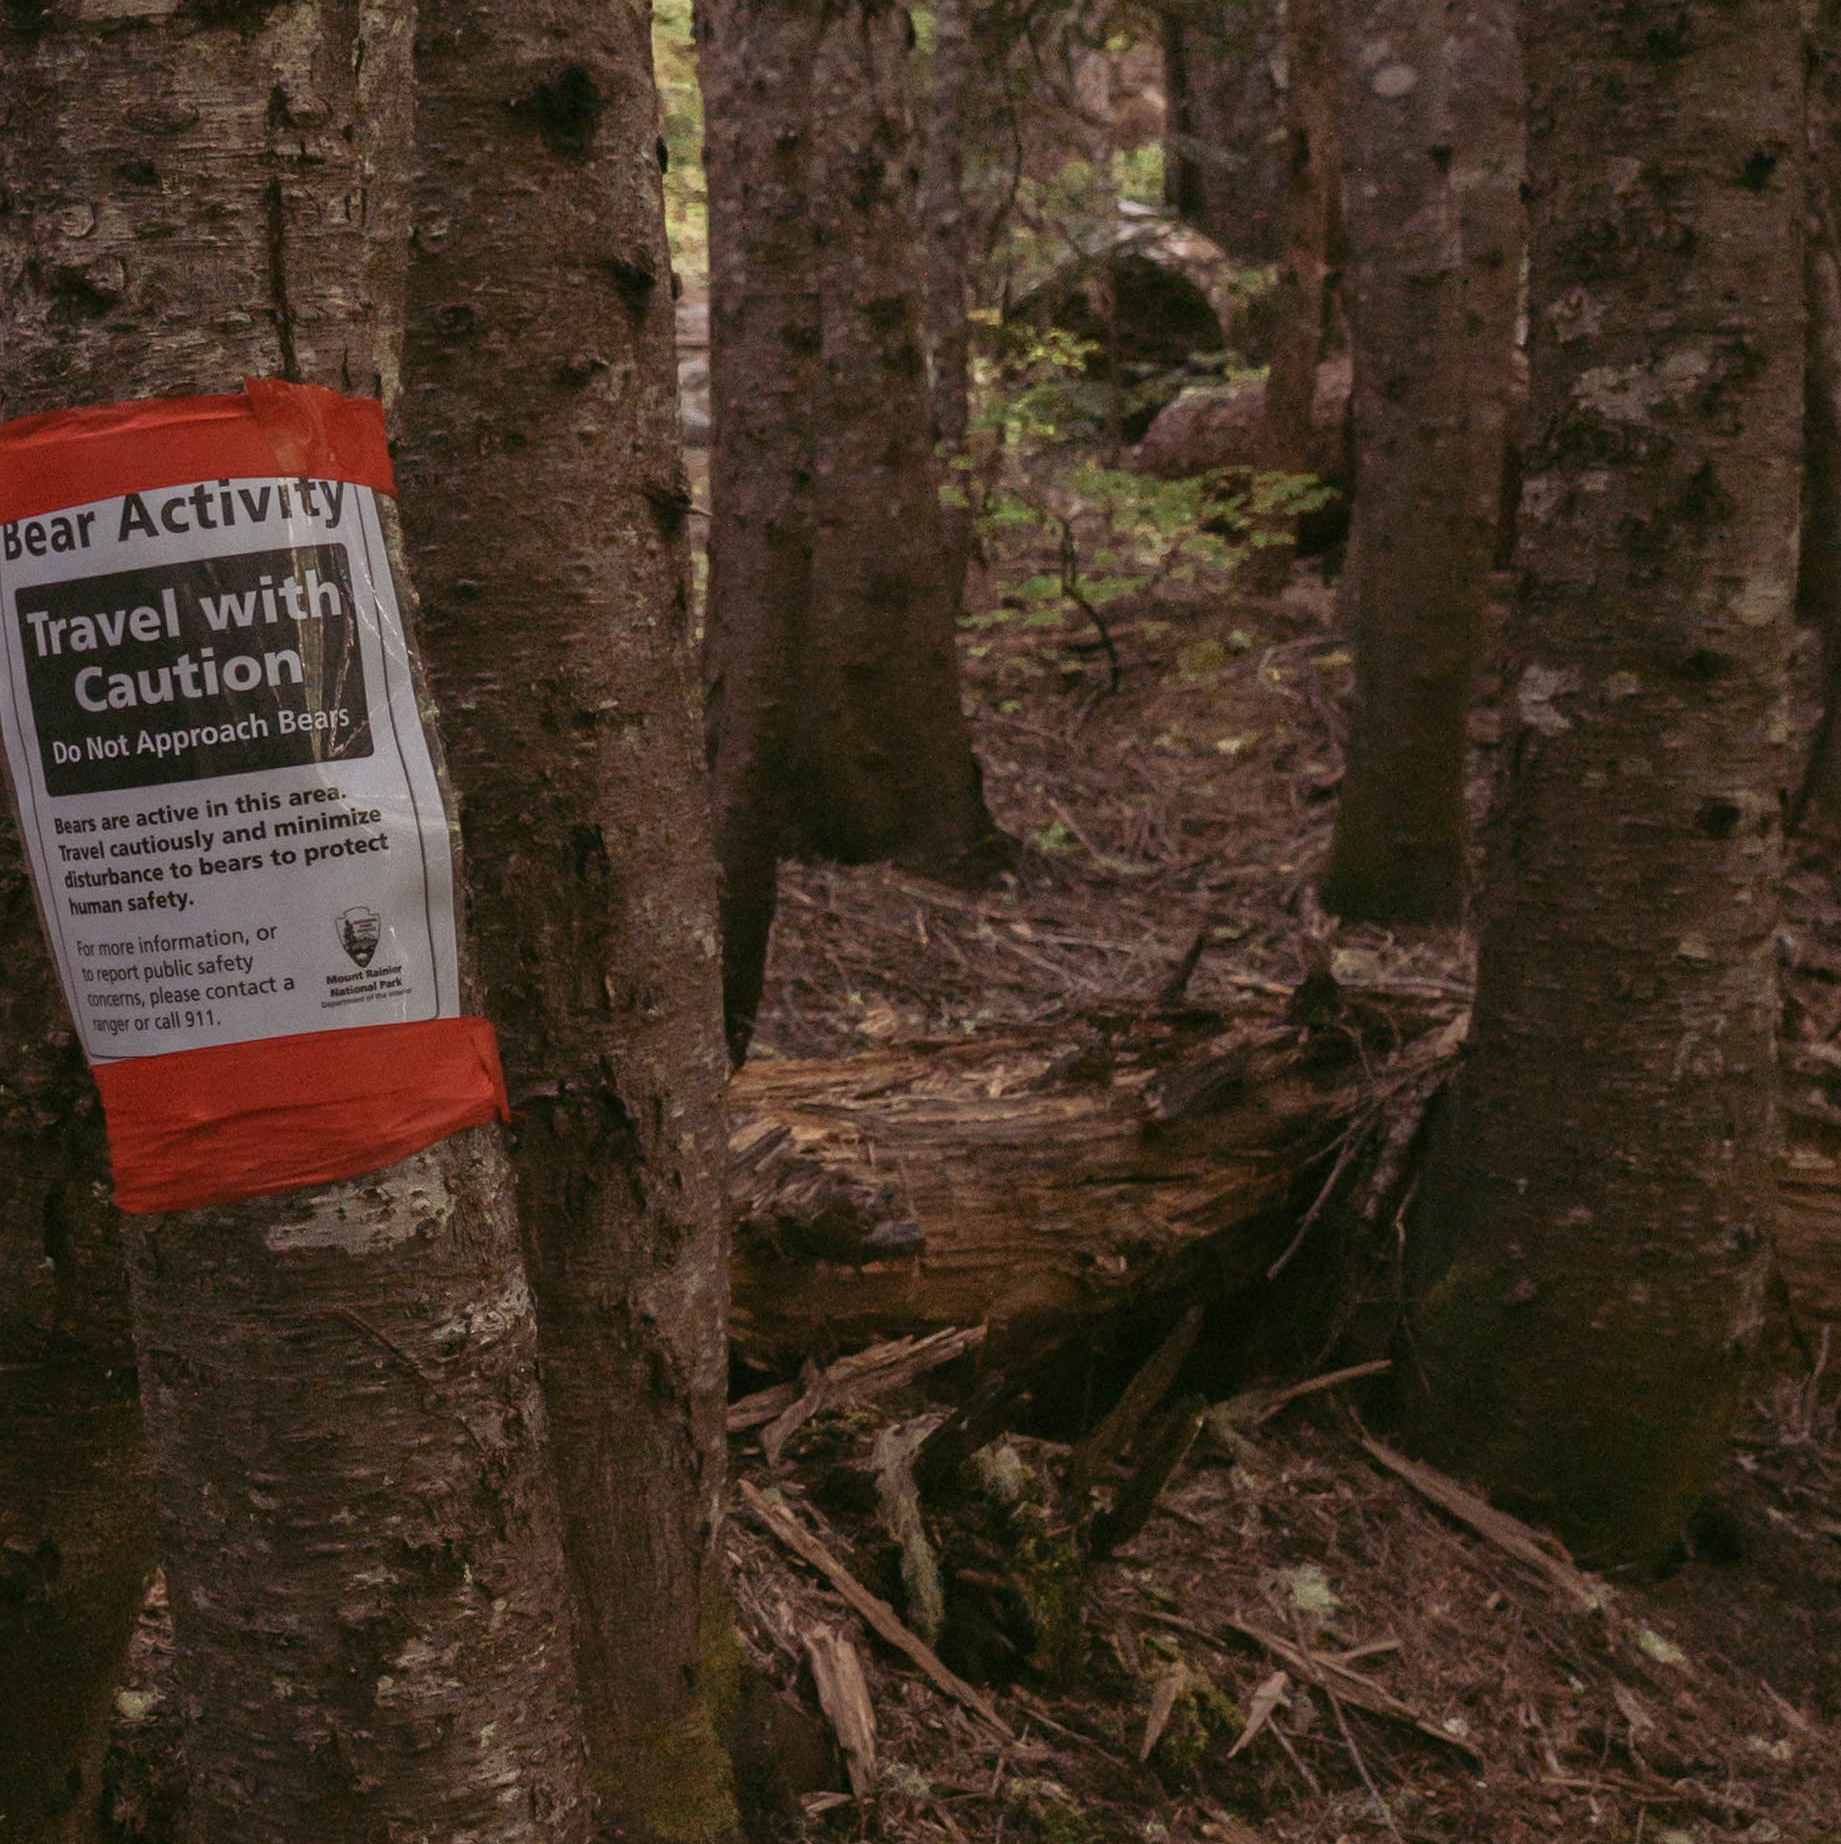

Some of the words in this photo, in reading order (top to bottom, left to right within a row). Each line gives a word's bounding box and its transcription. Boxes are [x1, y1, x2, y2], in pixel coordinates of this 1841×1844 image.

[4, 511, 96, 561] Bear
[118, 477, 344, 543] Activity
[26, 587, 181, 657] Travel
[199, 569, 342, 632] with
[74, 647, 305, 712] Caution
[52, 740, 80, 764] Do
[86, 733, 130, 759] Not
[136, 713, 269, 758] Approach
[278, 707, 350, 736] Bears
[54, 816, 97, 834] Bears
[101, 815, 130, 831] are
[136, 805, 200, 827] active
[206, 799, 228, 819] in
[234, 793, 281, 815] this
[288, 785, 347, 807] area.
[58, 840, 105, 862] Travel
[109, 829, 215, 859] cautiously
[222, 821, 266, 845] and
[274, 806, 382, 838] minimize
[64, 868, 164, 890] disturbance
[169, 862, 193, 880] to
[199, 855, 264, 876] bears
[270, 848, 297, 868] to
[304, 832, 390, 867] protect
[68, 897, 123, 916] human
[127, 889, 194, 913] safety.
[76, 940, 95, 957] For
[98, 940, 134, 956] more
[138, 928, 250, 954] information,
[255, 925, 278, 941] or
[82, 967, 94, 982] to
[97, 964, 140, 985] report
[143, 958, 194, 983] public
[197, 954, 254, 975] safety
[325, 971, 364, 985] Mount
[366, 964, 402, 978] Rainier
[330, 981, 377, 997] National
[379, 976, 403, 989] Park
[87, 991, 145, 1008] concerns,
[149, 986, 201, 1008] please
[205, 976, 278, 1000] contact
[283, 976, 296, 991] a
[92, 1017, 131, 1036] ranger
[134, 1017, 150, 1032] or
[154, 1011, 181, 1030] call
[185, 1009, 222, 1028] 911.
